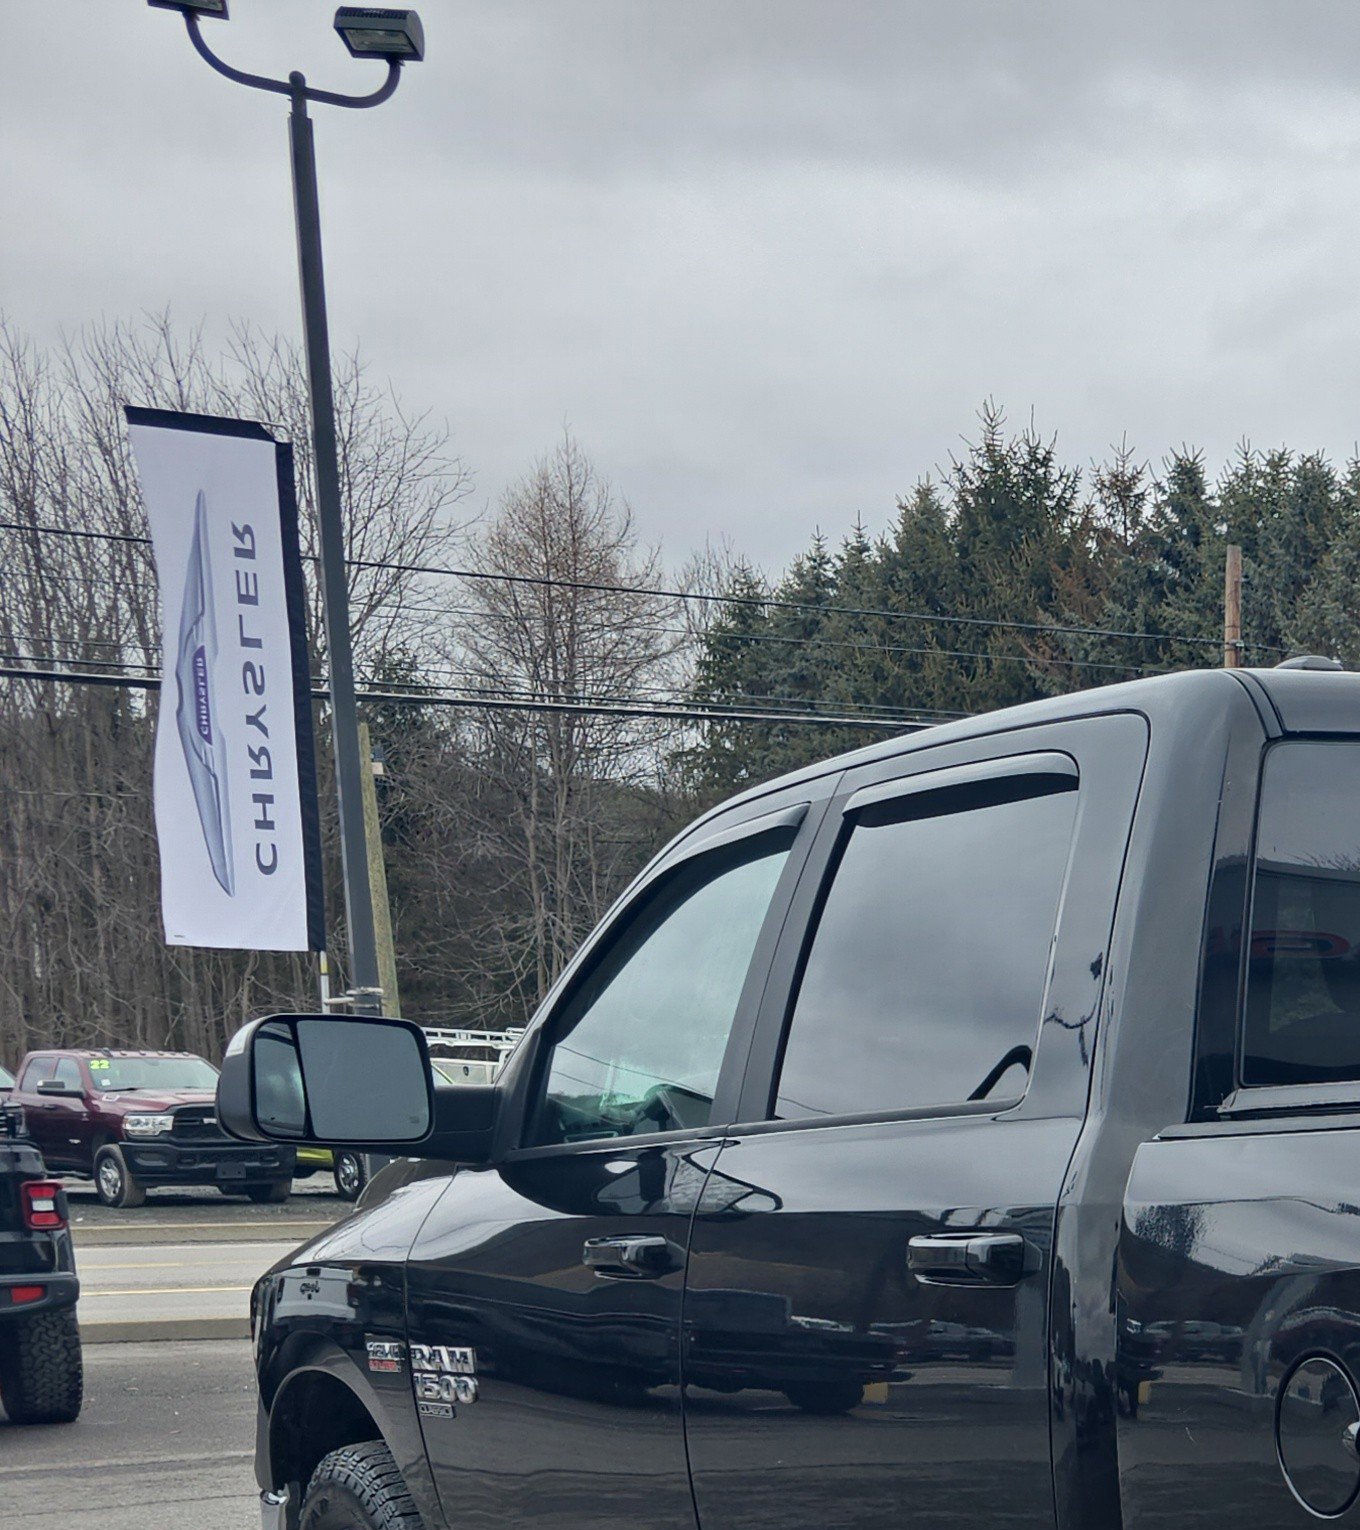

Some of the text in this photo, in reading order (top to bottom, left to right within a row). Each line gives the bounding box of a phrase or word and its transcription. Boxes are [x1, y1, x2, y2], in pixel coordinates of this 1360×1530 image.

[90, 1059, 110, 1070] 22
[410, 1344, 477, 1374] RAM
[413, 1372, 479, 1404] 1500
